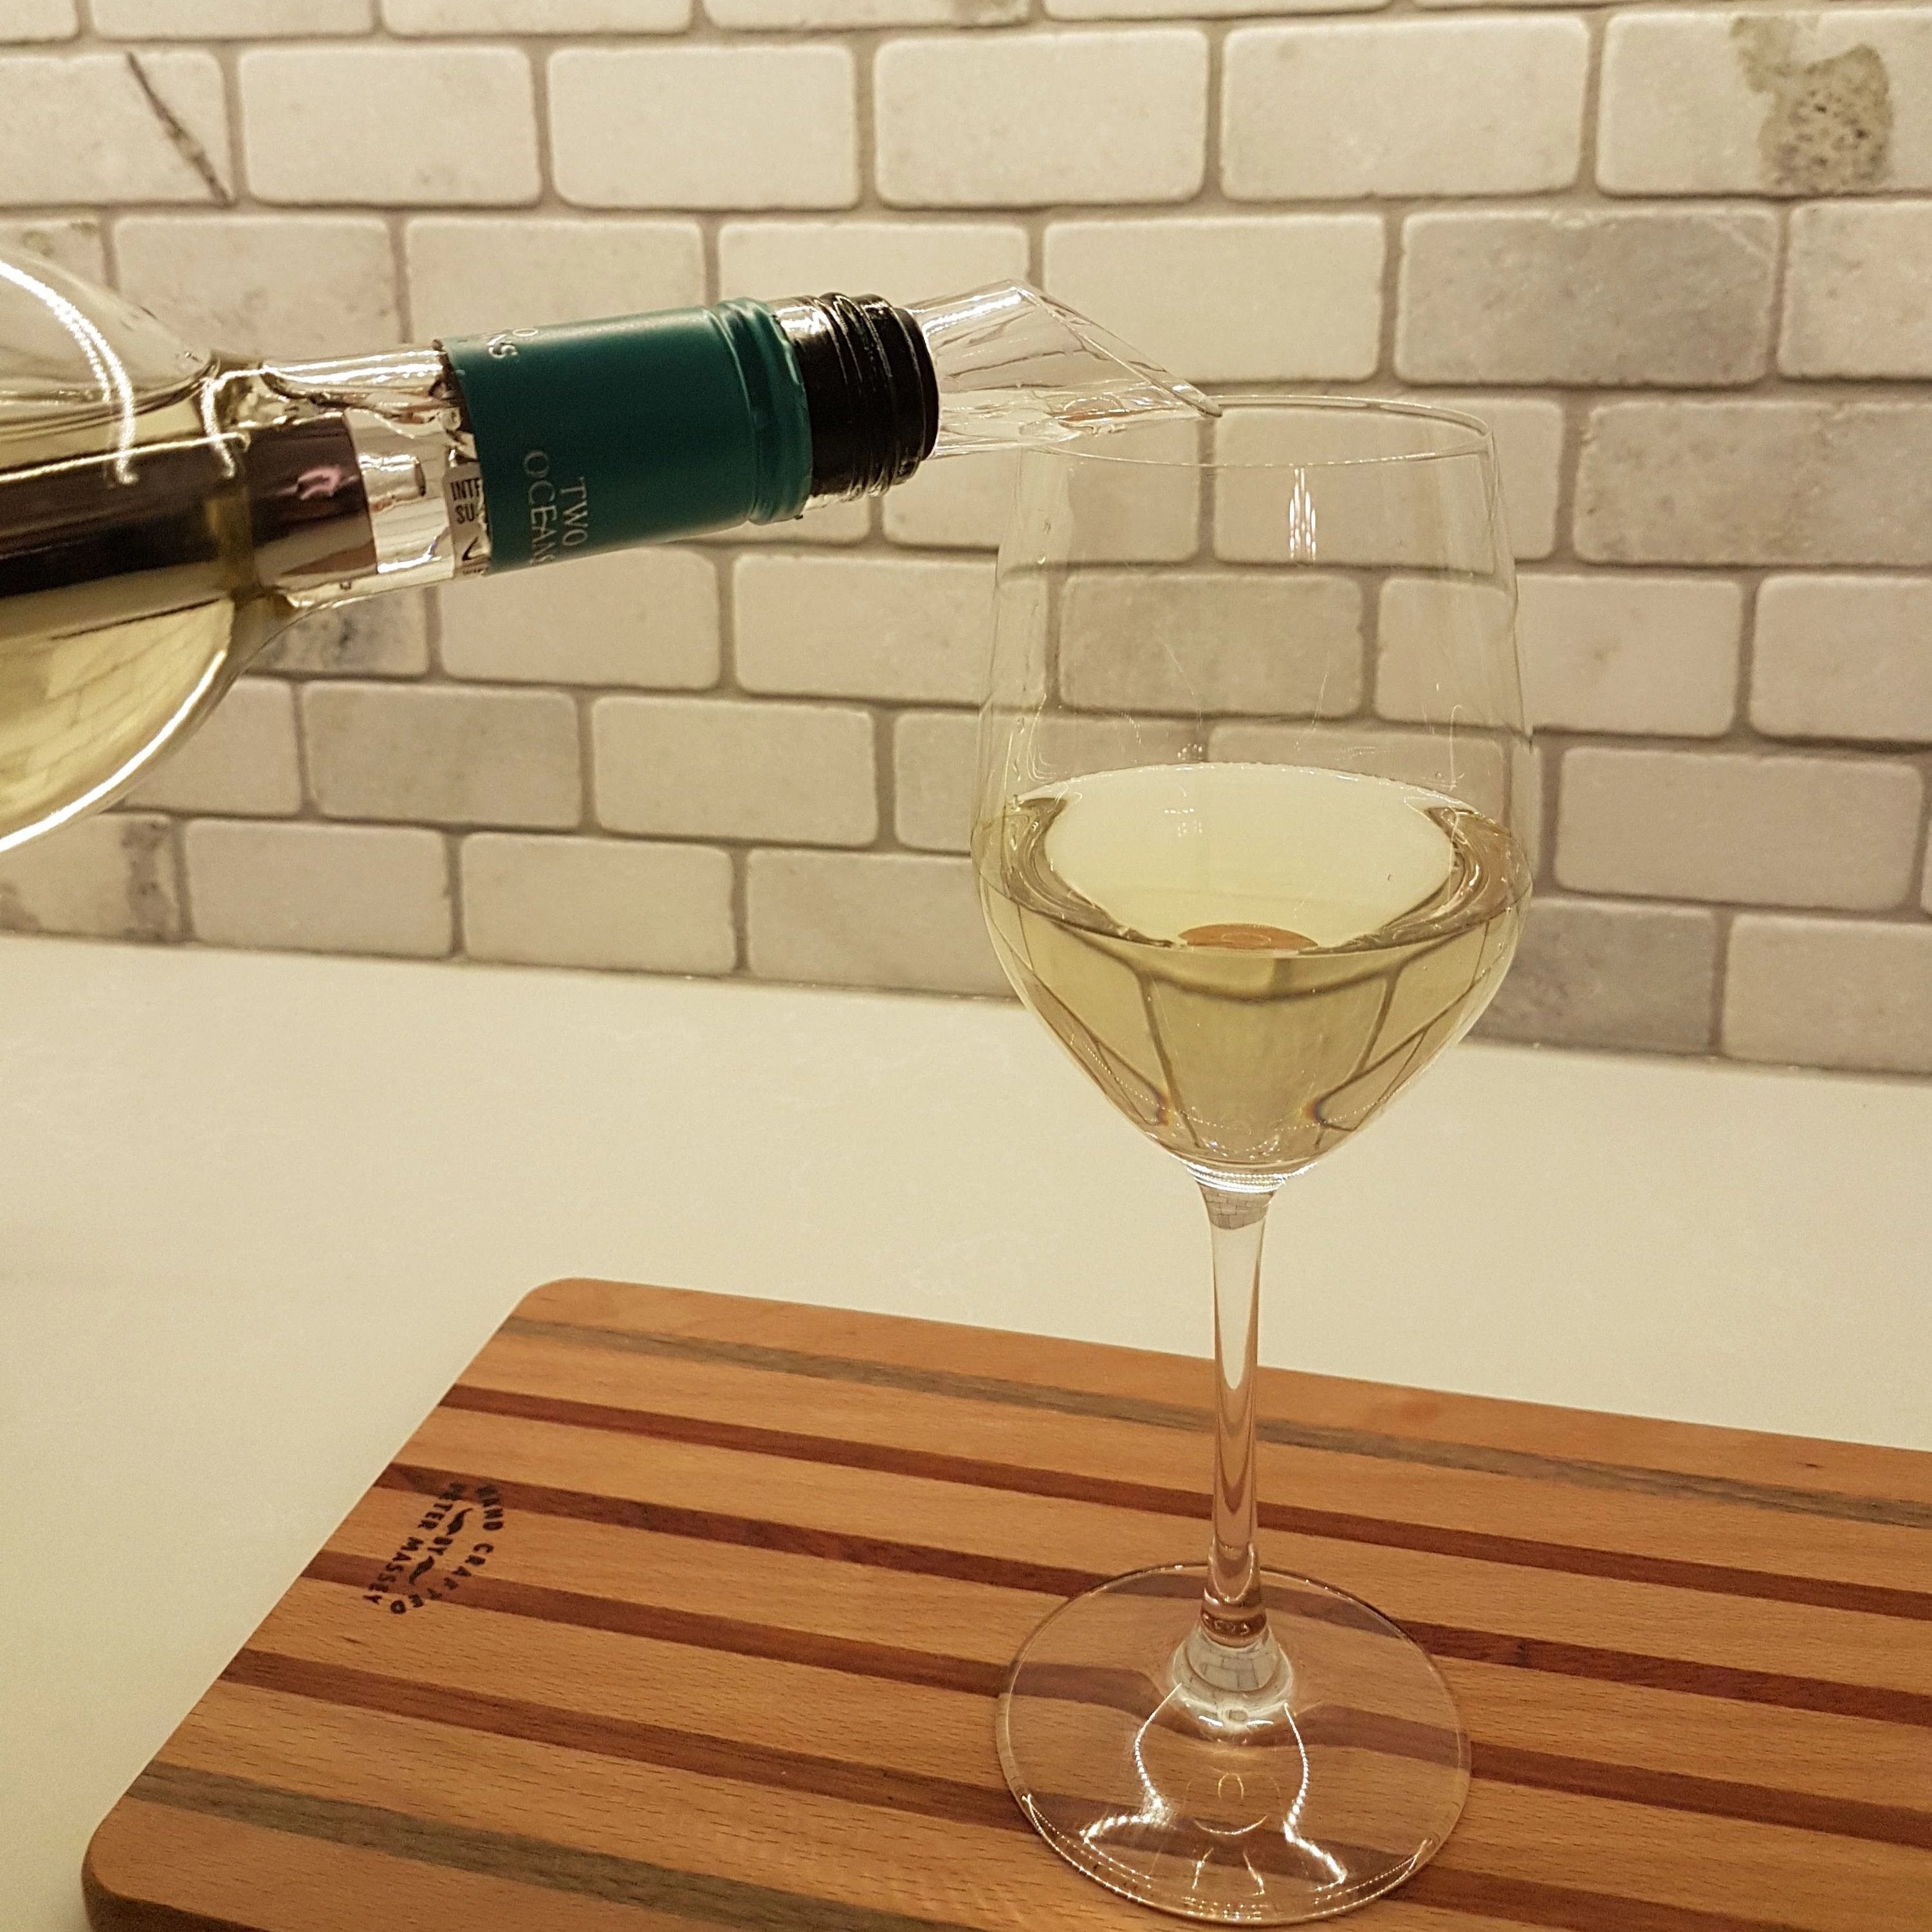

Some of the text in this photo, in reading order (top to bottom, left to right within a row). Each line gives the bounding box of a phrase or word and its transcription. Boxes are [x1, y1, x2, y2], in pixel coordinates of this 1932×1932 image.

[559, 476, 588, 546] TWO
[363, 1537, 424, 1605] MASSEY
[428, 1537, 453, 1556] BY
